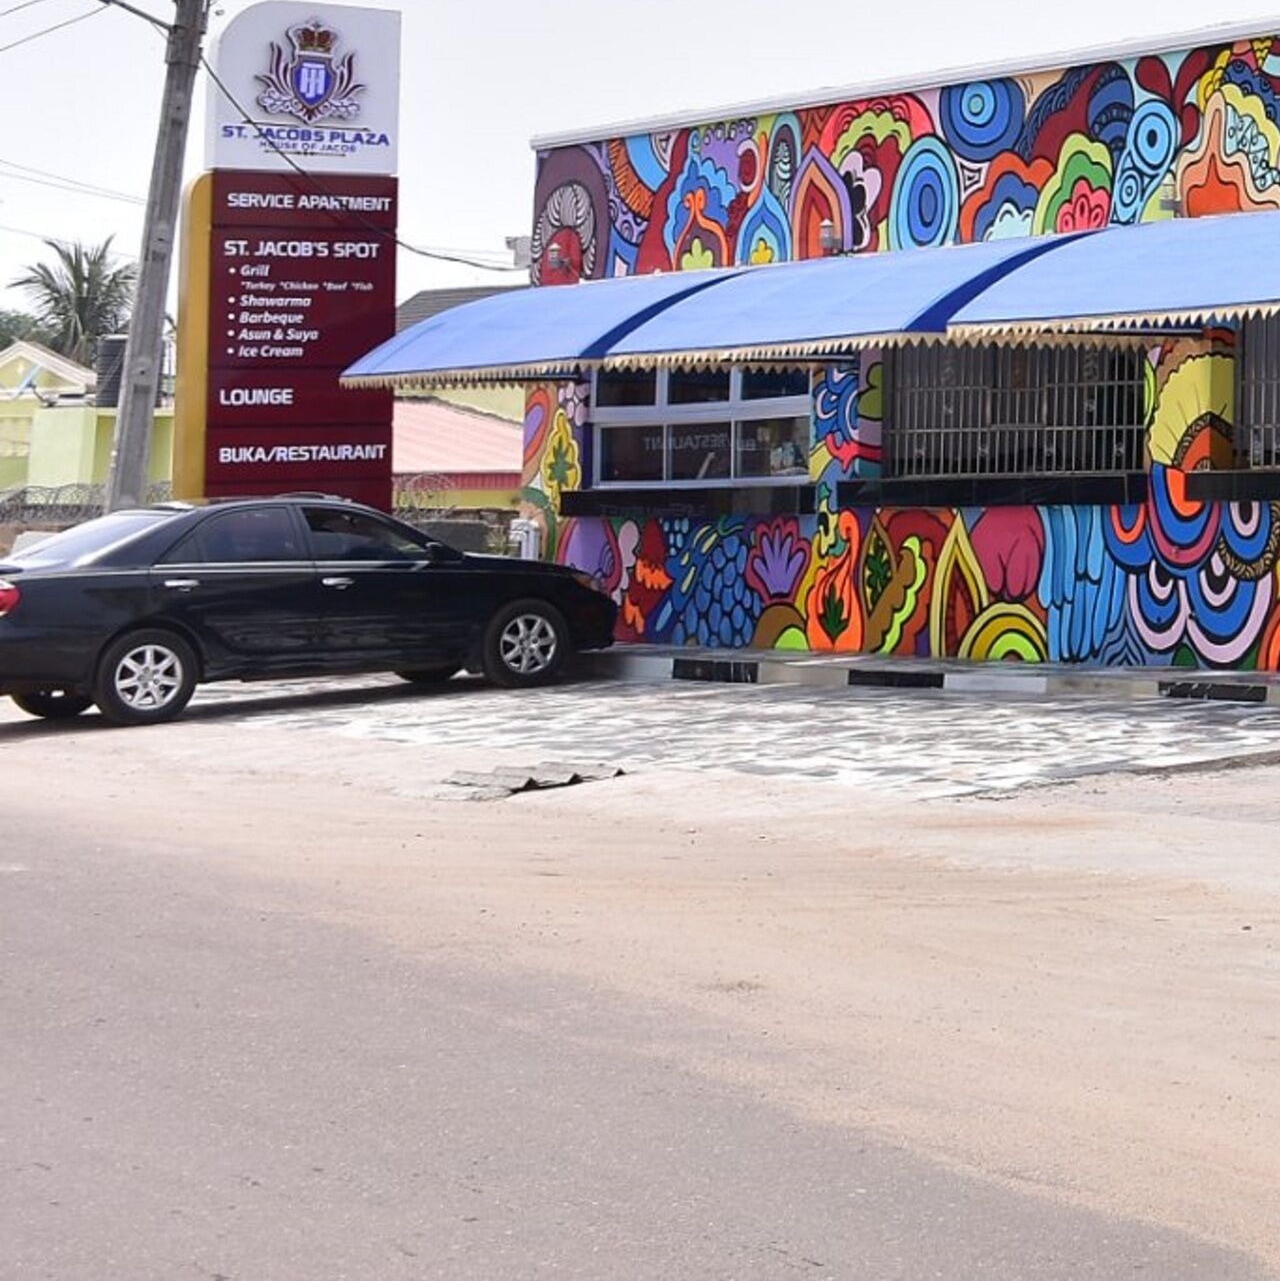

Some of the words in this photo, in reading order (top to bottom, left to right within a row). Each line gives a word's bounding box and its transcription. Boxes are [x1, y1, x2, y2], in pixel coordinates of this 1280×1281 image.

[222, 126, 247, 138] ST.
[254, 128, 324, 142] JACOBS
[330, 132, 389, 146] PLAZA
[320, 144, 356, 152] JACOB
[228, 194, 293, 208] SERVICE
[224, 241, 250, 256] ST.
[254, 242, 328, 257] JACOB'S
[334, 243, 379, 258] SPOT
[240, 265, 270, 276] Grill
[240, 295, 312, 307] Shawarma
[240, 312, 304, 324] Barbeque
[238, 328, 271, 340] Asun
[274, 328, 284, 340] &
[286, 328, 318, 342] Suya
[238, 345, 258, 357] Ice
[260, 346, 303, 357] Cream
[220, 389, 293, 404] LOUNGE
[219, 444, 386, 462] BUKA/RESTAURANT
